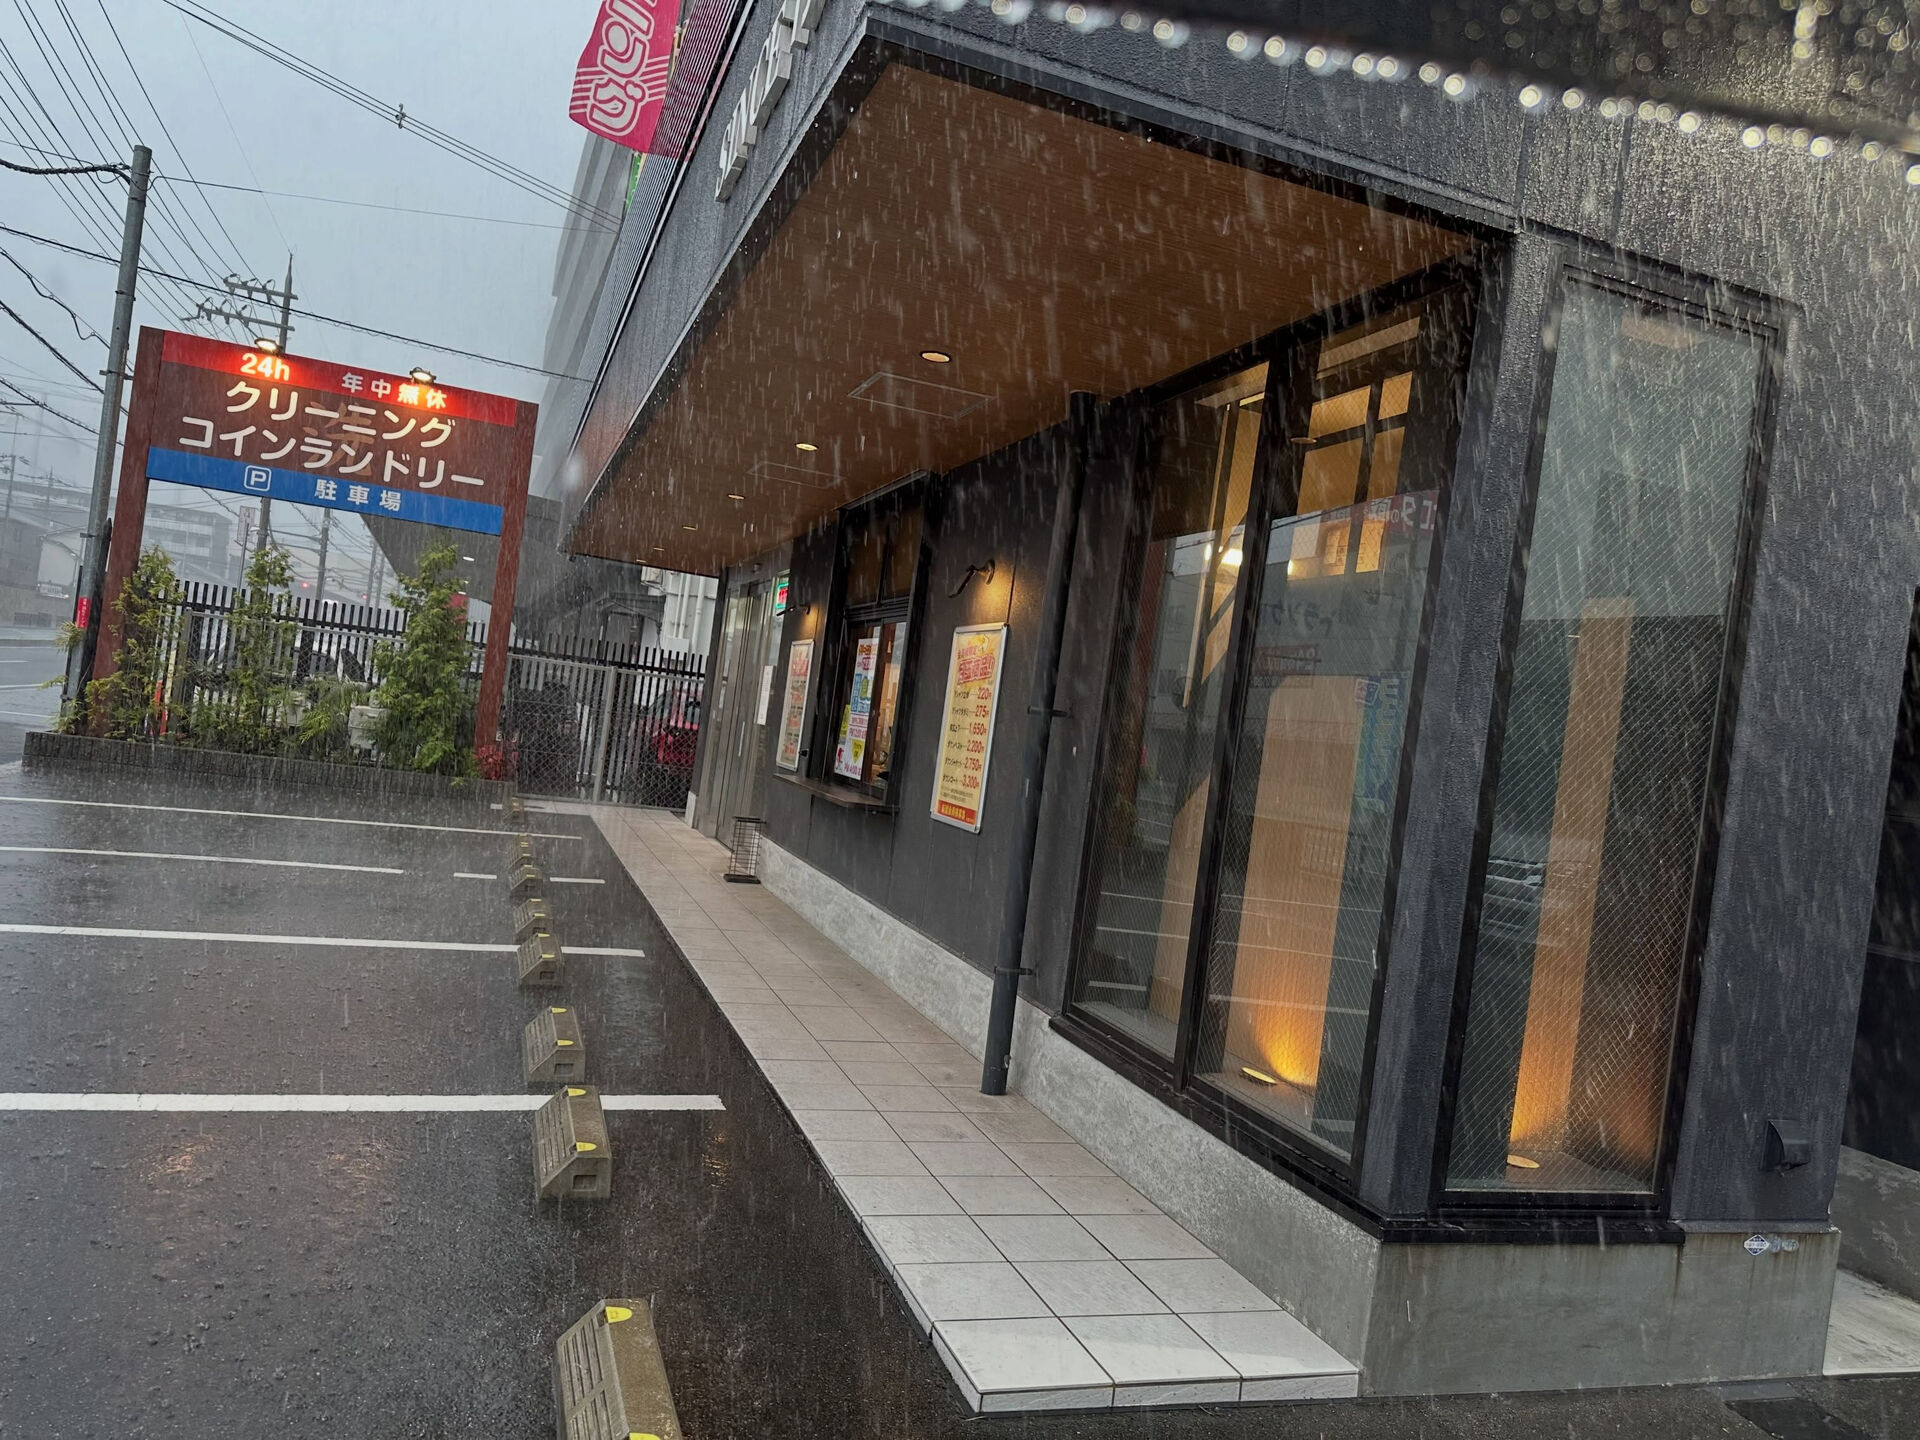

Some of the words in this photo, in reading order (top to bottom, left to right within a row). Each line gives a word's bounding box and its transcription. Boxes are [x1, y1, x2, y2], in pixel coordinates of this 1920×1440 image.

[240, 353, 290, 381] 24h
[341, 371, 447, 410] 年中無休
[226, 380, 456, 448] クリーニング
[178, 416, 485, 488] コインランドリー
[314, 478, 402, 512] 駐車場
